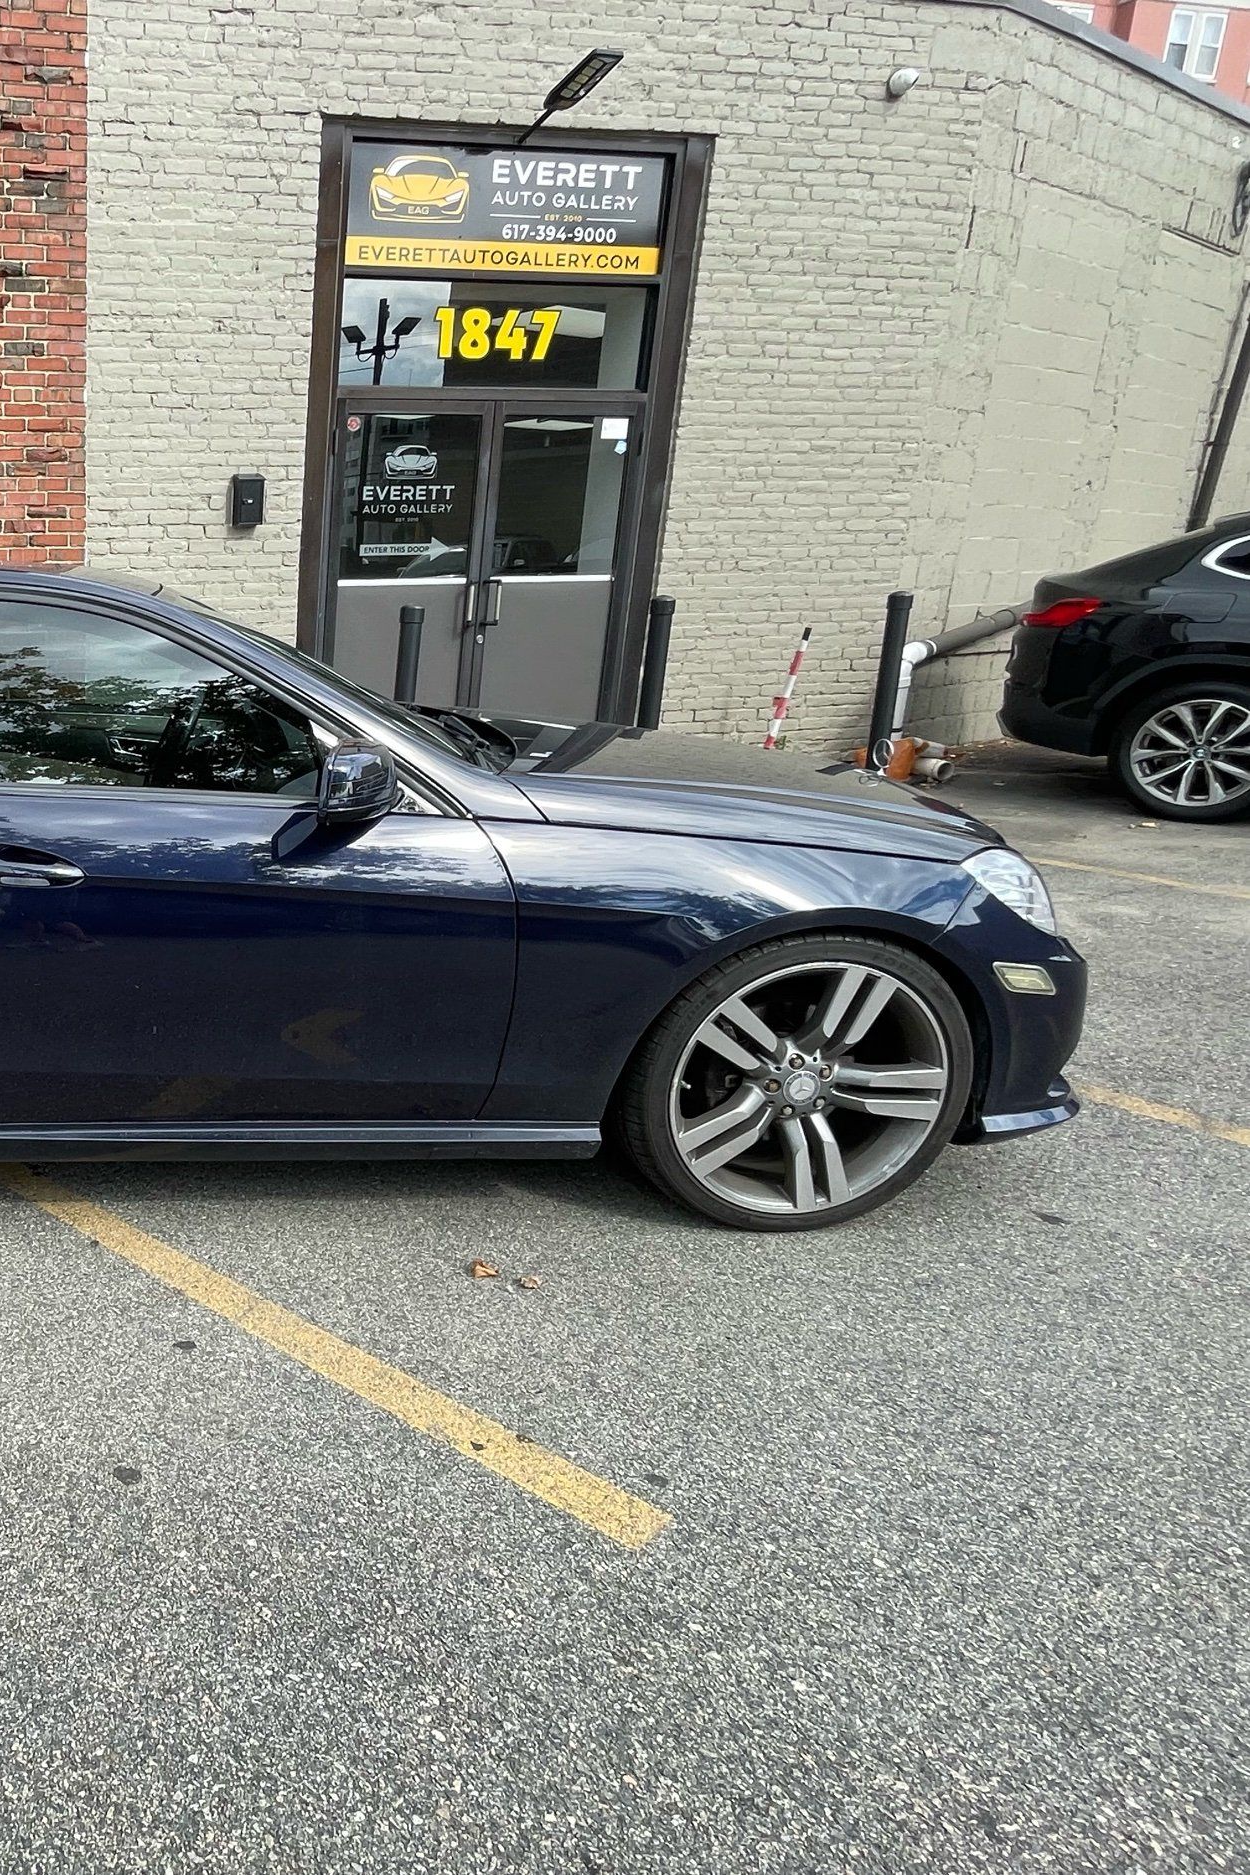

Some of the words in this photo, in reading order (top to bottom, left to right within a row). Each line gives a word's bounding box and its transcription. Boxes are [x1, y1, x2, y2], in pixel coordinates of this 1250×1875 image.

[492, 159, 643, 190] EVERETT
[407, 205, 430, 216] EAG
[491, 190, 546, 207] AUTO
[552, 193, 639, 211] GALLERY
[502, 223, 617, 244] 617-394-9000
[358, 245, 640, 270] EVERETTAUTOGALLERY.COM
[436, 307, 561, 361] 1847
[362, 485, 455, 501] EVERETT
[362, 504, 396, 514] AUTO
[399, 503, 453, 514] GALLERY
[364, 546, 388, 554] ENTER
[407, 545, 429, 553] DOOR
